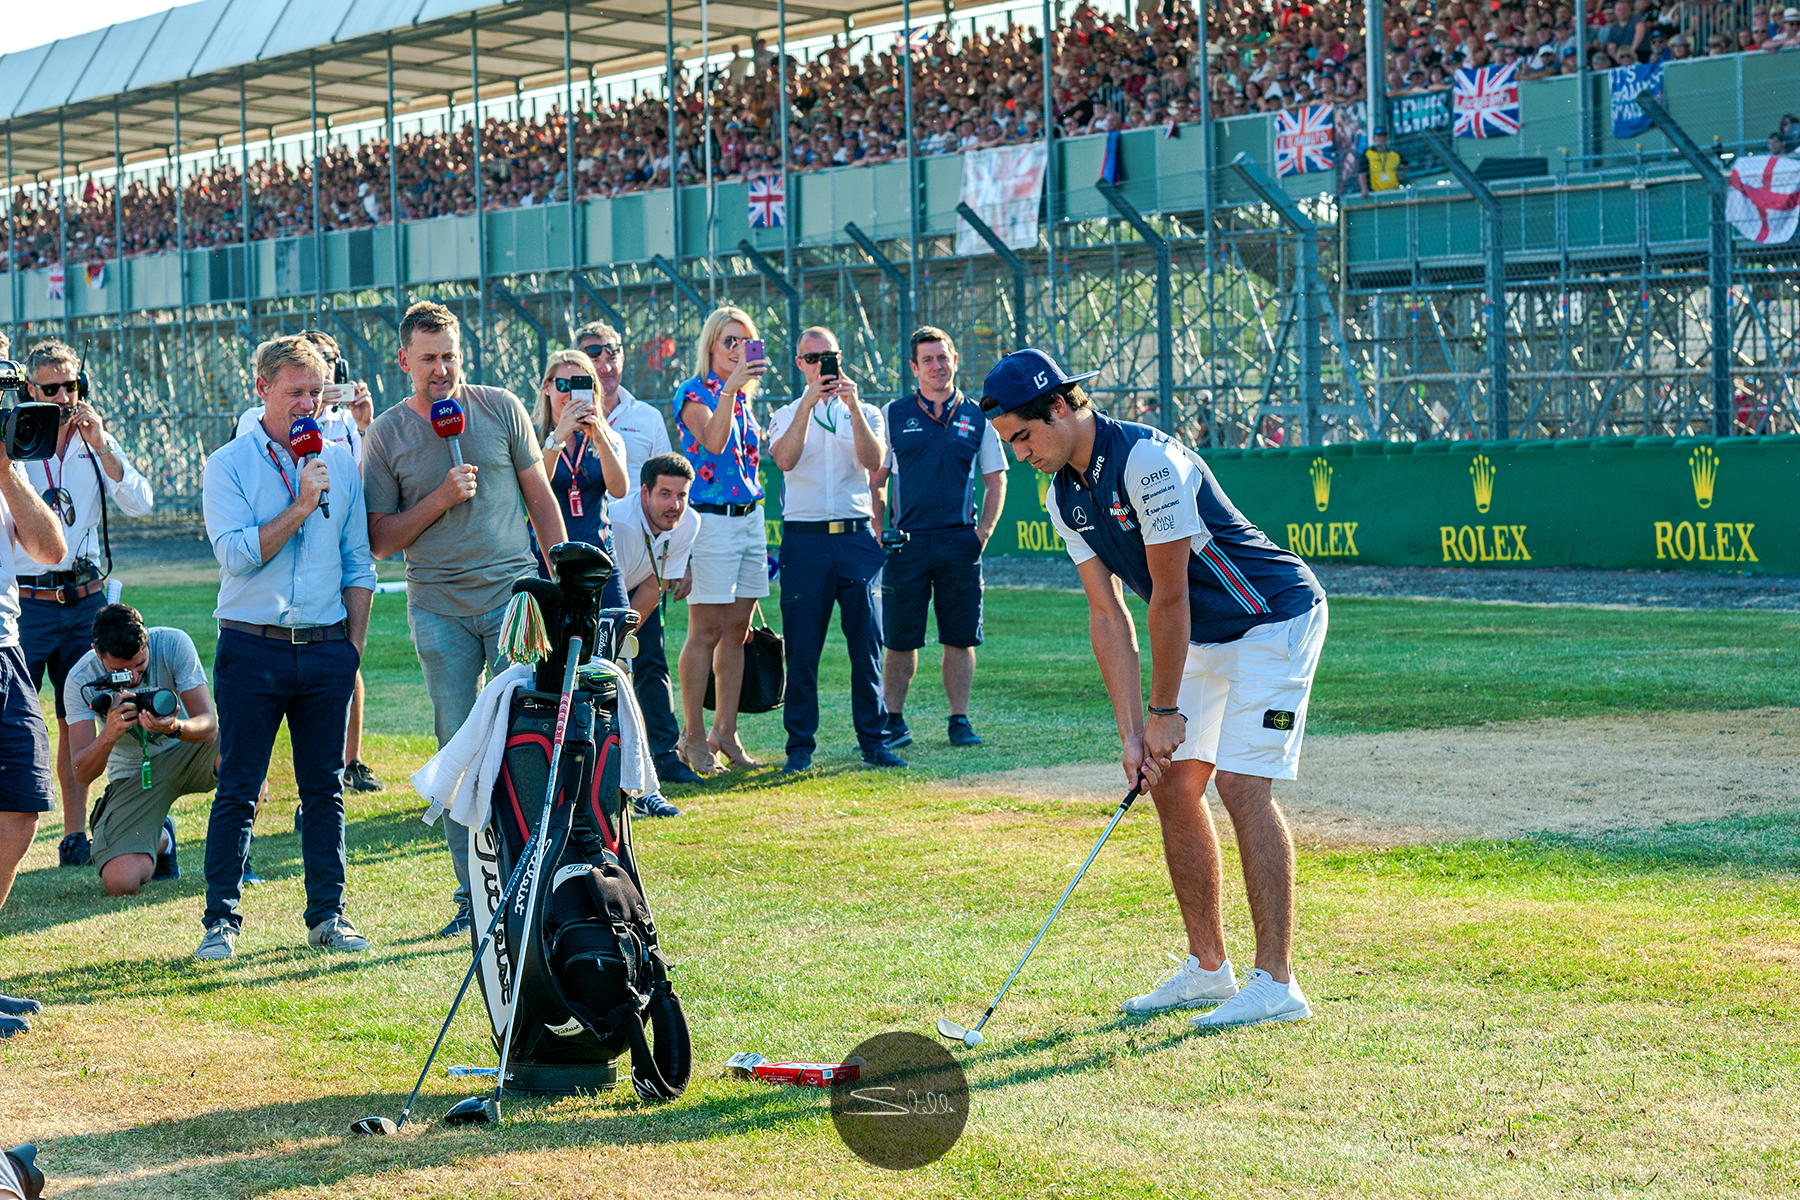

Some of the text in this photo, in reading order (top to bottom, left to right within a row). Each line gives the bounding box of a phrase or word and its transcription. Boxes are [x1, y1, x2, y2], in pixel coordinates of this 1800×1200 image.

[438, 406, 453, 416] sky
[292, 423, 305, 434] sky
[437, 416, 462, 427] sports
[290, 433, 311, 446] sports
[1140, 467, 1170, 486] ORIS
[1016, 520, 1066, 551] ROLE
[1286, 522, 1359, 557] ROLEX
[1440, 525, 1532, 563] ROLEX
[1654, 521, 1759, 562] ROLEX
